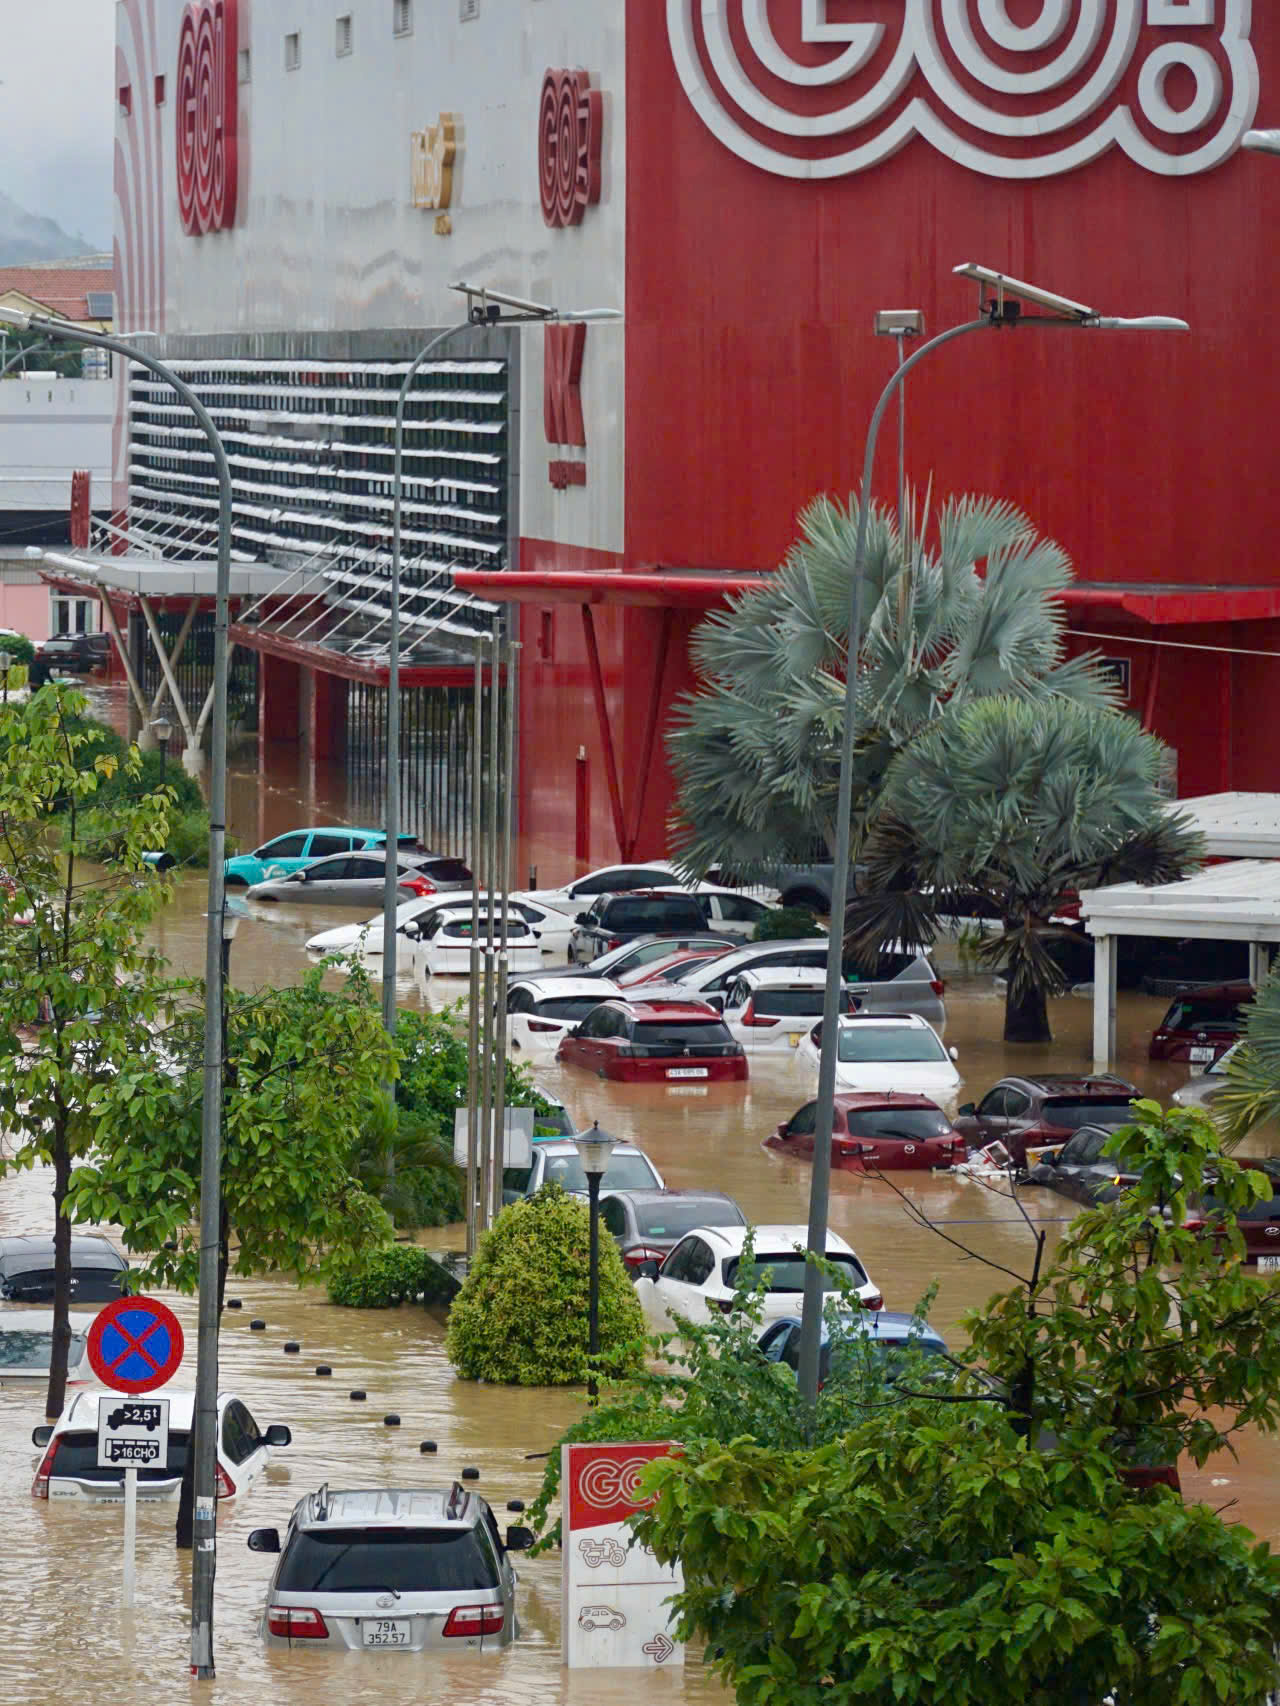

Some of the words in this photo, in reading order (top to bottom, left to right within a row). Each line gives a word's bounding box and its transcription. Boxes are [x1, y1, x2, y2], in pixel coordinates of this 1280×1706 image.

[579, 1457, 662, 1509] GO
[376, 1621, 397, 1633] 79A
[368, 1633, 406, 1645] 352.57
